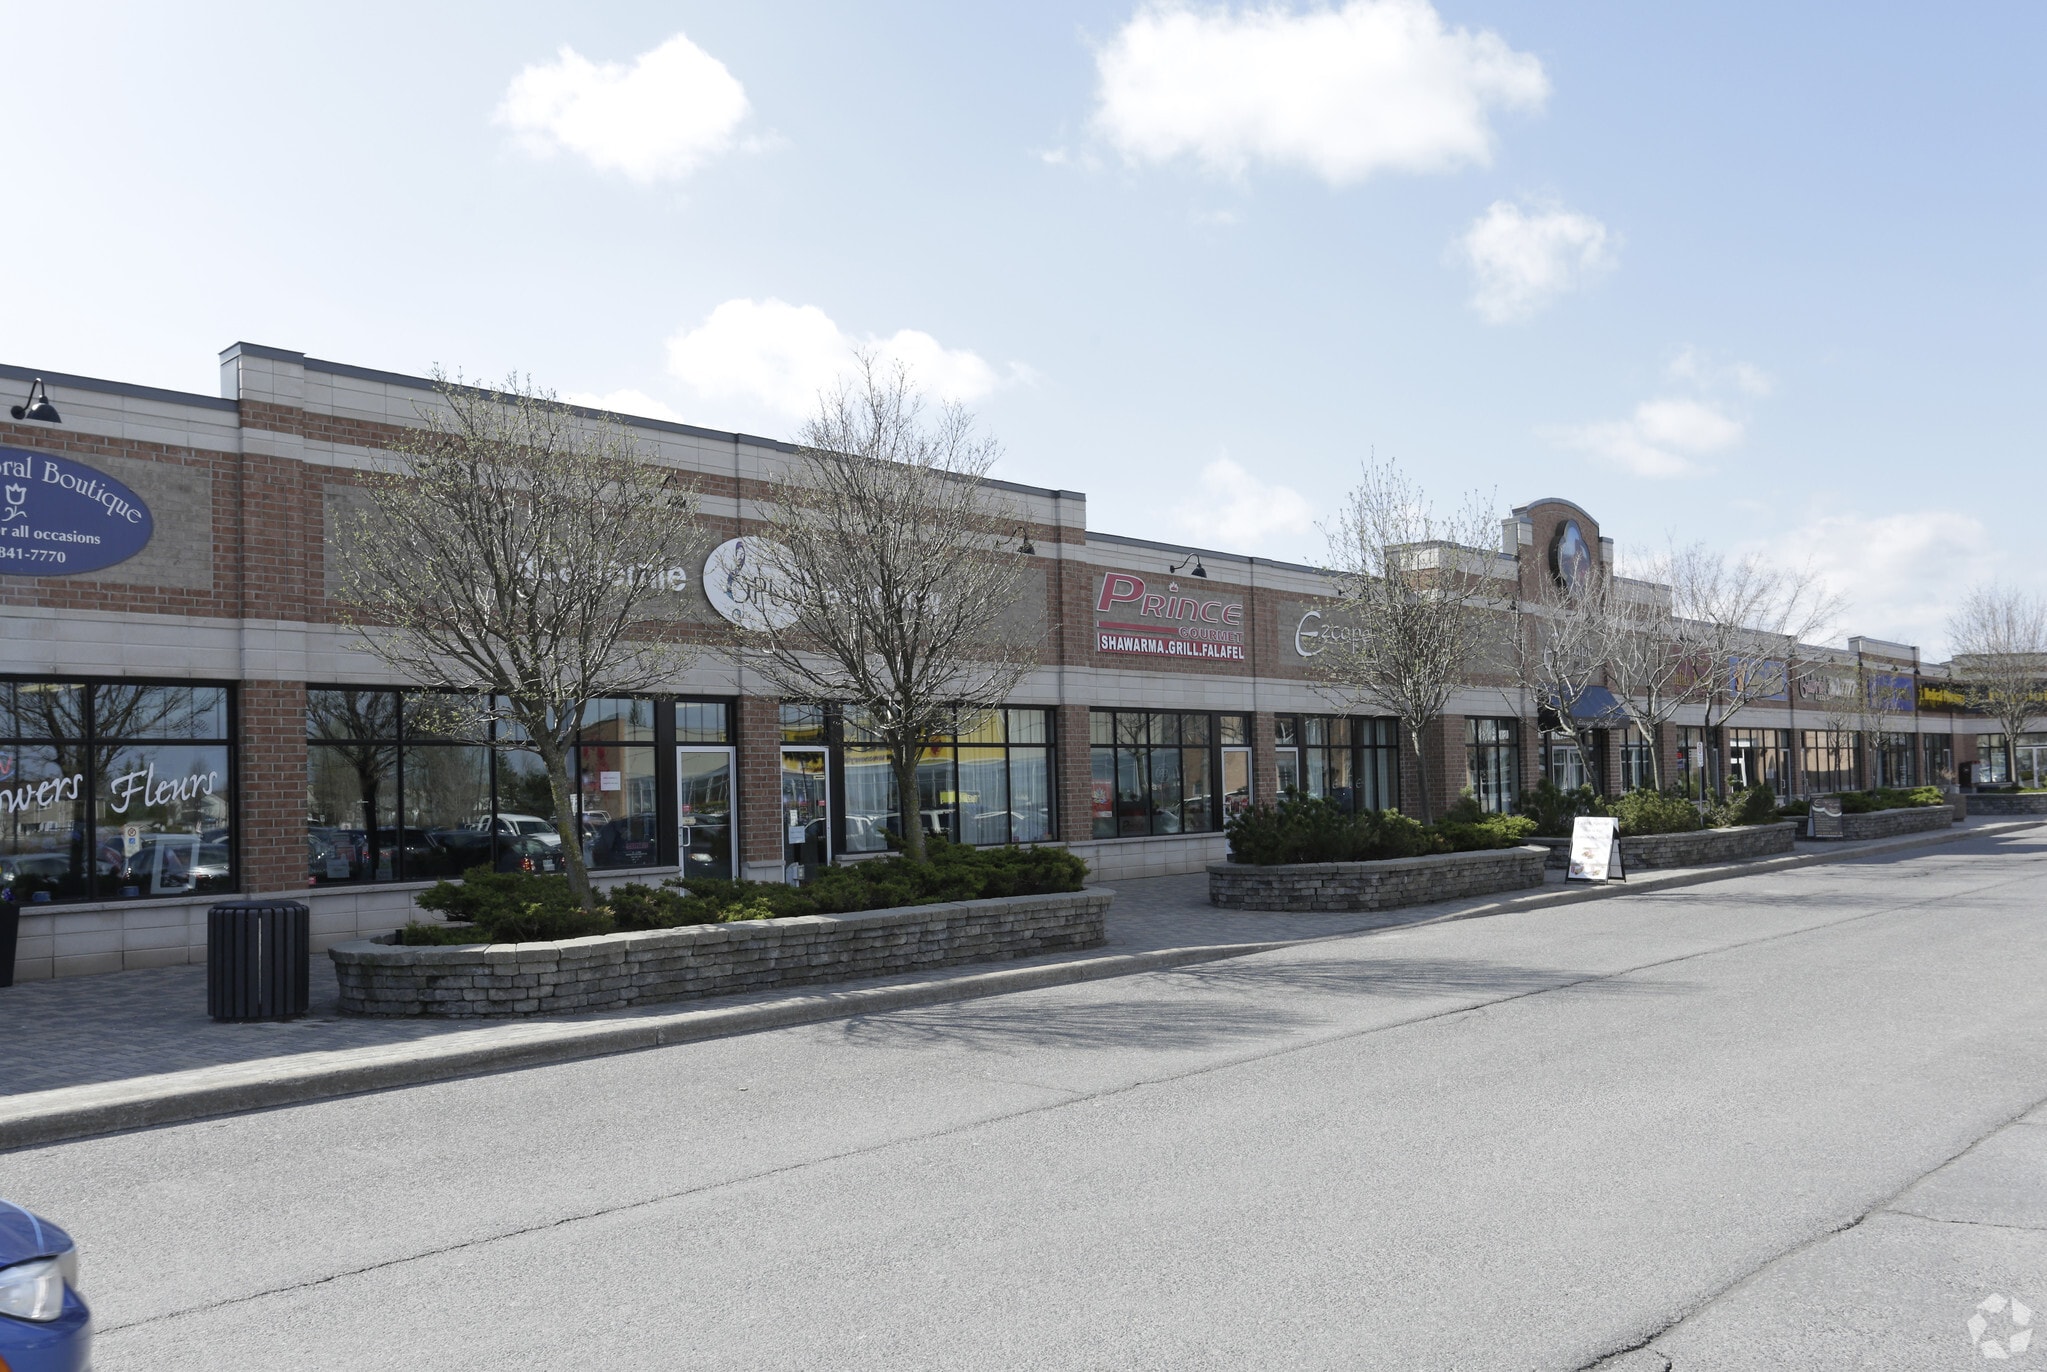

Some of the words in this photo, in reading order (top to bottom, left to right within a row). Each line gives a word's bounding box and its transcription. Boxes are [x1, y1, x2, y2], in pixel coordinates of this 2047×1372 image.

[0, 456, 32, 479] ral
[42, 461, 142, 524] Boutique
[11, 525, 29, 538] all
[33, 530, 101, 545] occasions
[1178, 626, 1244, 643] GOURMET
[0, 773, 83, 814] wers
[111, 762, 218, 814] Fleurs
